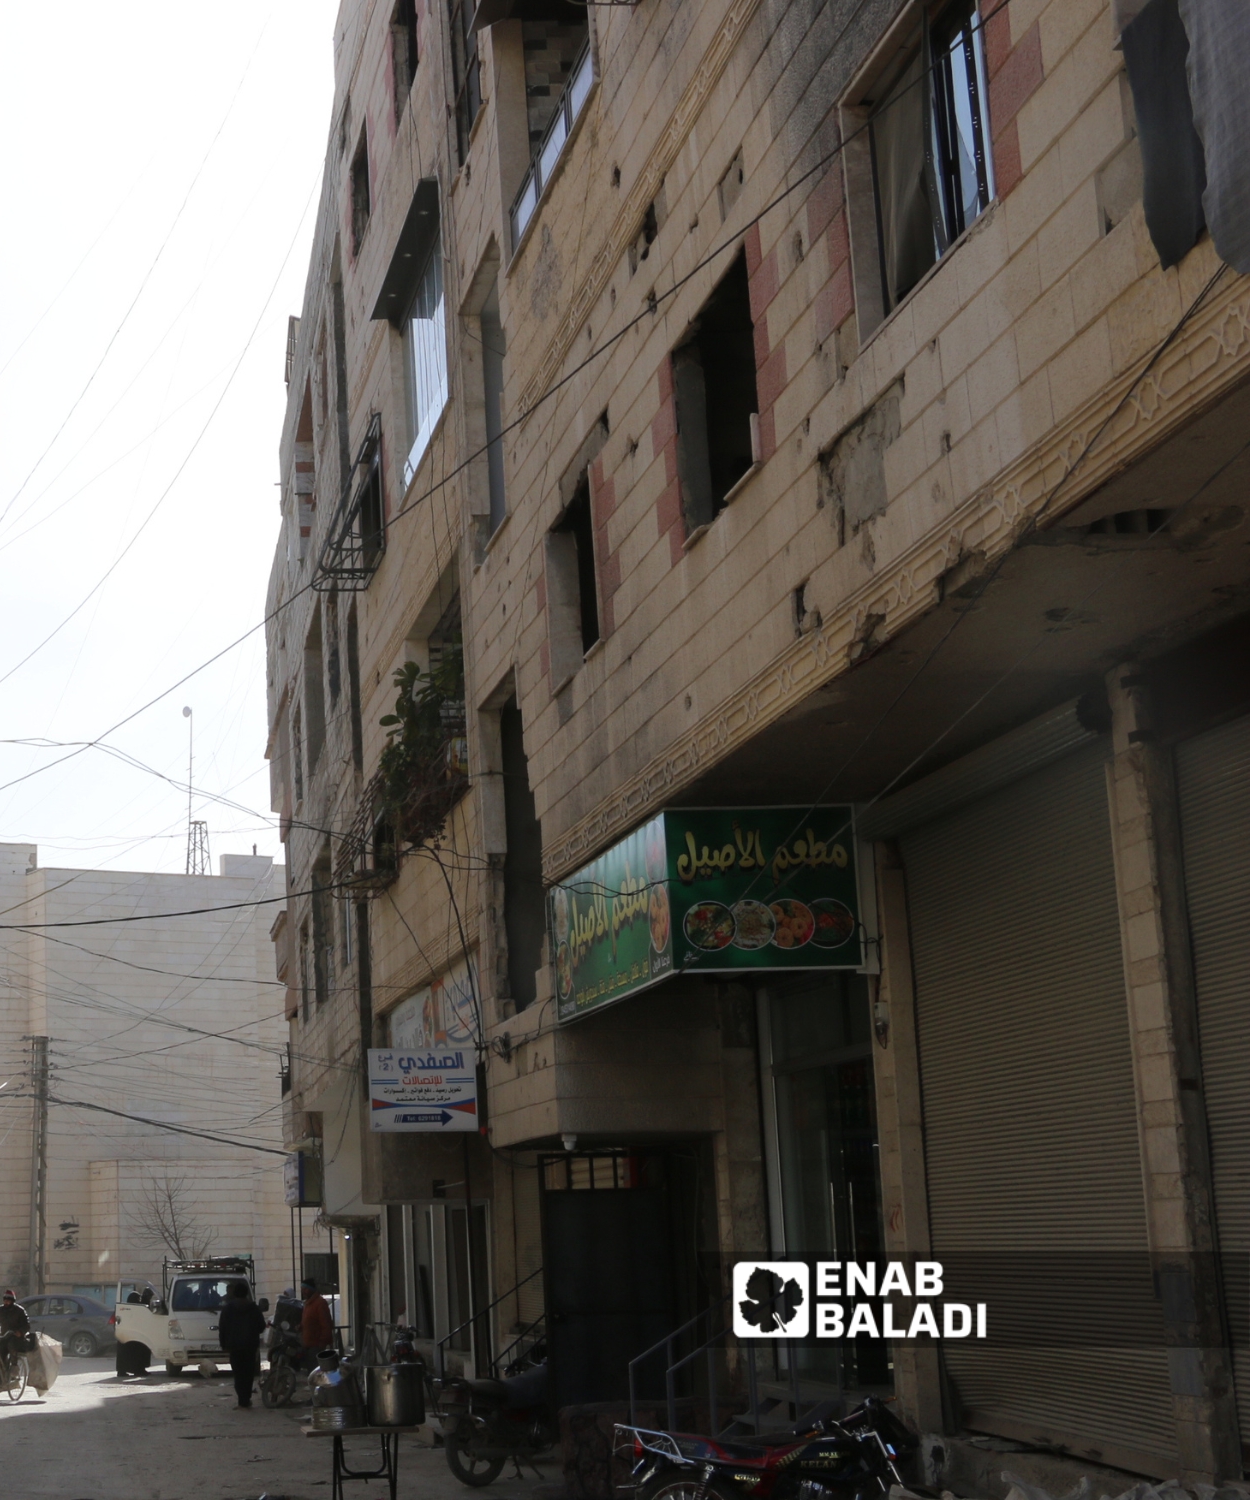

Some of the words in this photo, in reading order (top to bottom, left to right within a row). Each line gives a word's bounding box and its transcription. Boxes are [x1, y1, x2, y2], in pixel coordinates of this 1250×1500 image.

[772, 827, 848, 888] مطعم
[611, 860, 648, 957] مطعم
[378, 1053, 393, 1063] فرع
[398, 1051, 465, 1074] الصفدي
[448, 1086, 461, 1094] تحويل
